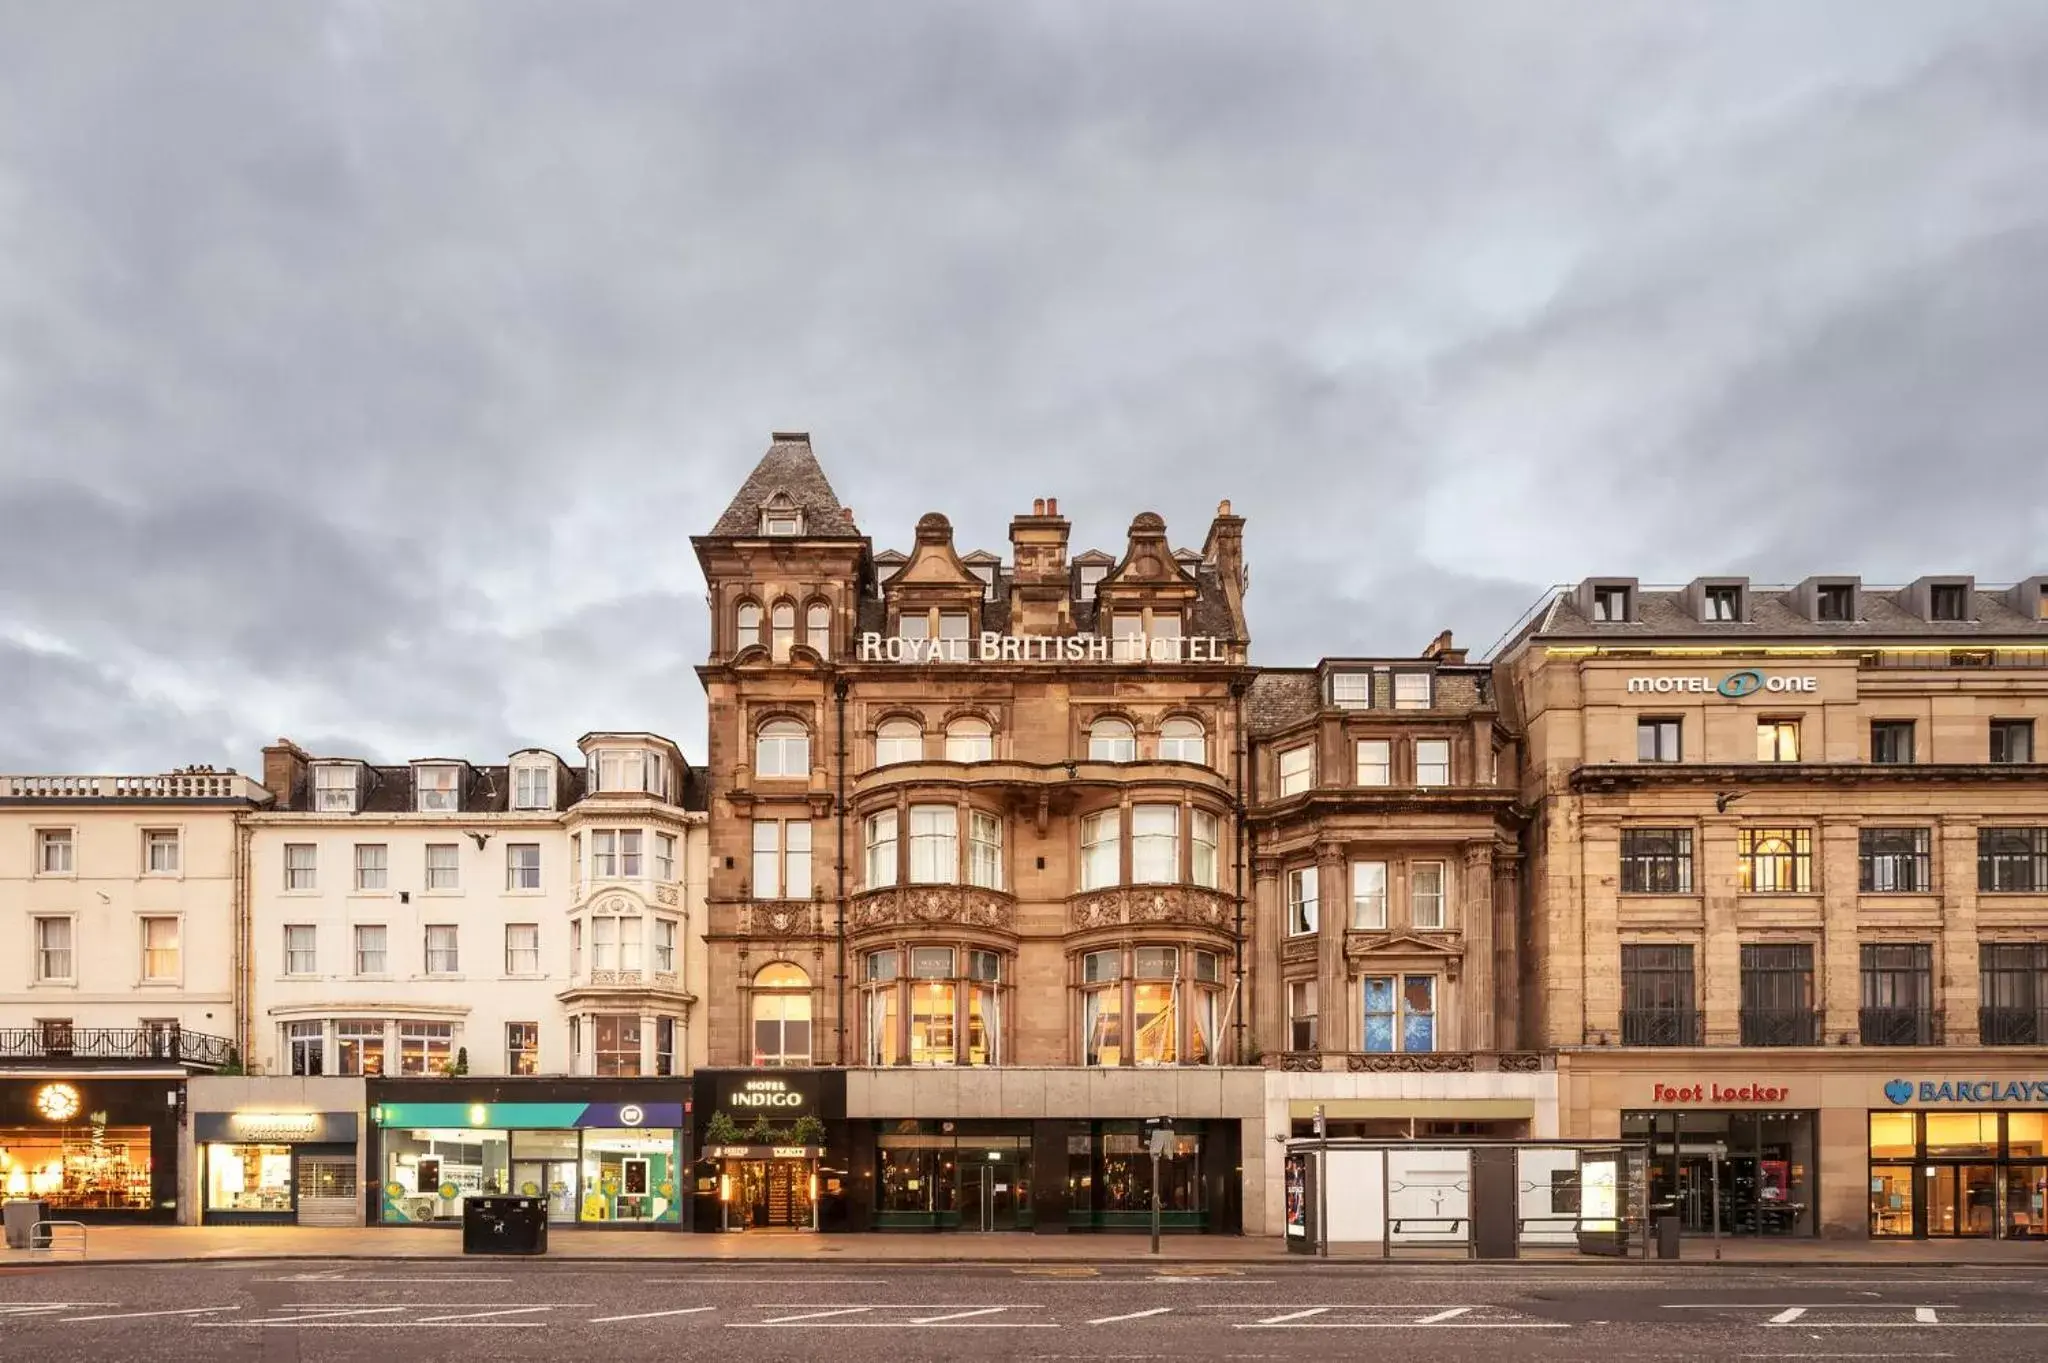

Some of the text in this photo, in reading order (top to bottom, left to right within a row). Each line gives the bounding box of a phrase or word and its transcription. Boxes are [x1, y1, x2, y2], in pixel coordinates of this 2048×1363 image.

[862, 630, 1225, 662] ROYAL BRITISH HOTEL
[746, 1081, 786, 1091] HOTEL
[1653, 1082, 1789, 1102] Foot Locker
[1919, 1080, 2048, 1102] BARCLAYS
[732, 1092, 802, 1106] INDIGO
